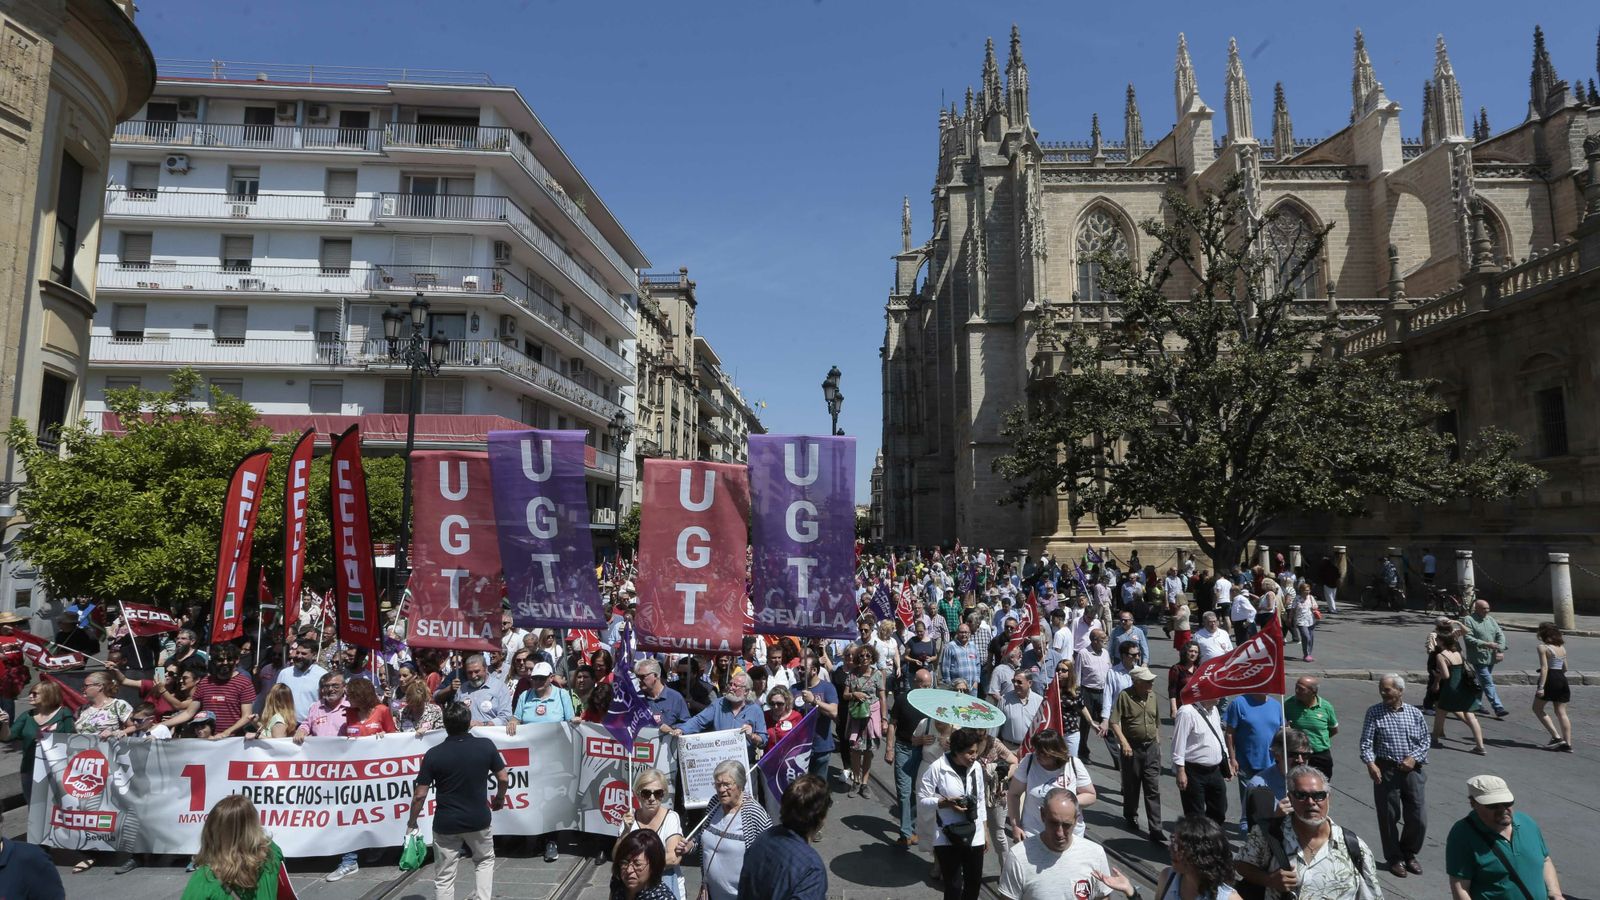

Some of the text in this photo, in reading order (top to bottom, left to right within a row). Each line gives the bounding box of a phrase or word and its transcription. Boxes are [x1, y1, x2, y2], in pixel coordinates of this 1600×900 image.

[517, 602, 597, 620] SEVILLA
[760, 607, 848, 630] SEVILLA
[416, 618, 494, 639] SEVILLA
[72, 757, 105, 777] UGT
[246, 756, 425, 779] LA LUCHA CON
[181, 764, 206, 811] 1
[54, 811, 98, 828] CCOO
[260, 809, 330, 828] IMERO
[336, 806, 386, 827] LAS
[85, 832, 116, 842] Sevilla
